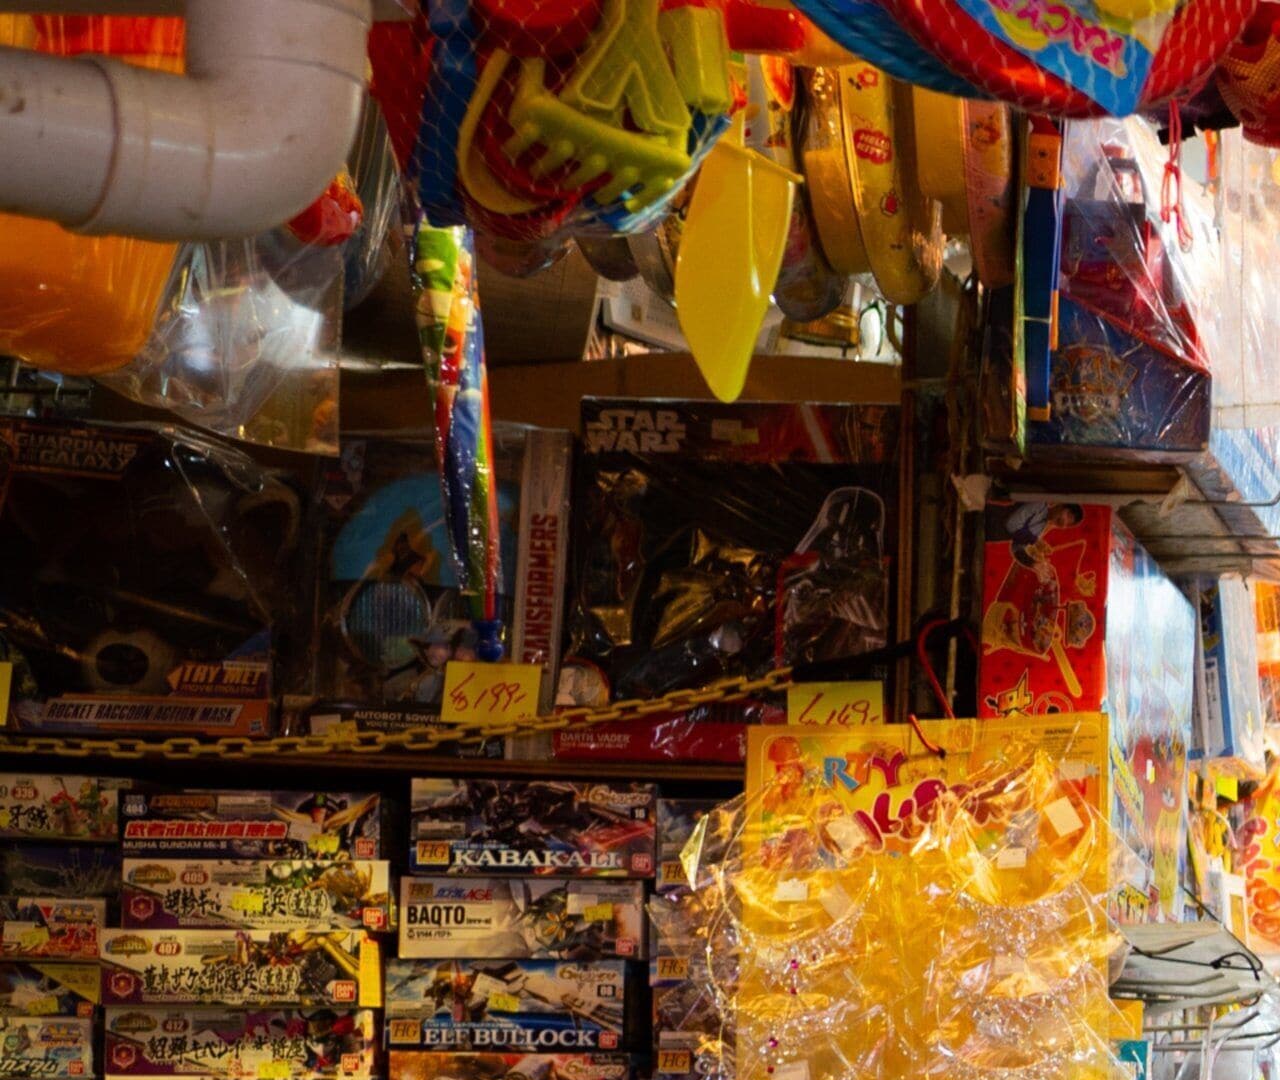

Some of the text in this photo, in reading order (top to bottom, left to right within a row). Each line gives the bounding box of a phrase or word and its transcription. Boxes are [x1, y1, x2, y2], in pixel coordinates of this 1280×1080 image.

[598, 409, 682, 433] STAR
[14, 431, 138, 453] GUARDIANS
[586, 429, 687, 453] WARS
[38, 449, 134, 471] GALAXY
[524, 514, 558, 664] RANSFORMERS
[48, 702, 236, 722] ROCKET RACCOON ACTION MASK
[353, 710, 403, 720] AUTOBOT
[560, 732, 632, 743] DARTH VADER
[123, 840, 157, 850] MUSHA
[159, 840, 201, 850] GUNDAM
[419, 843, 448, 860] HG
[452, 849, 625, 868] KABAKALI
[406, 904, 466, 925] BAQTO
[392, 1022, 419, 1040] HG
[424, 1027, 597, 1047] ELF BULLOCK
